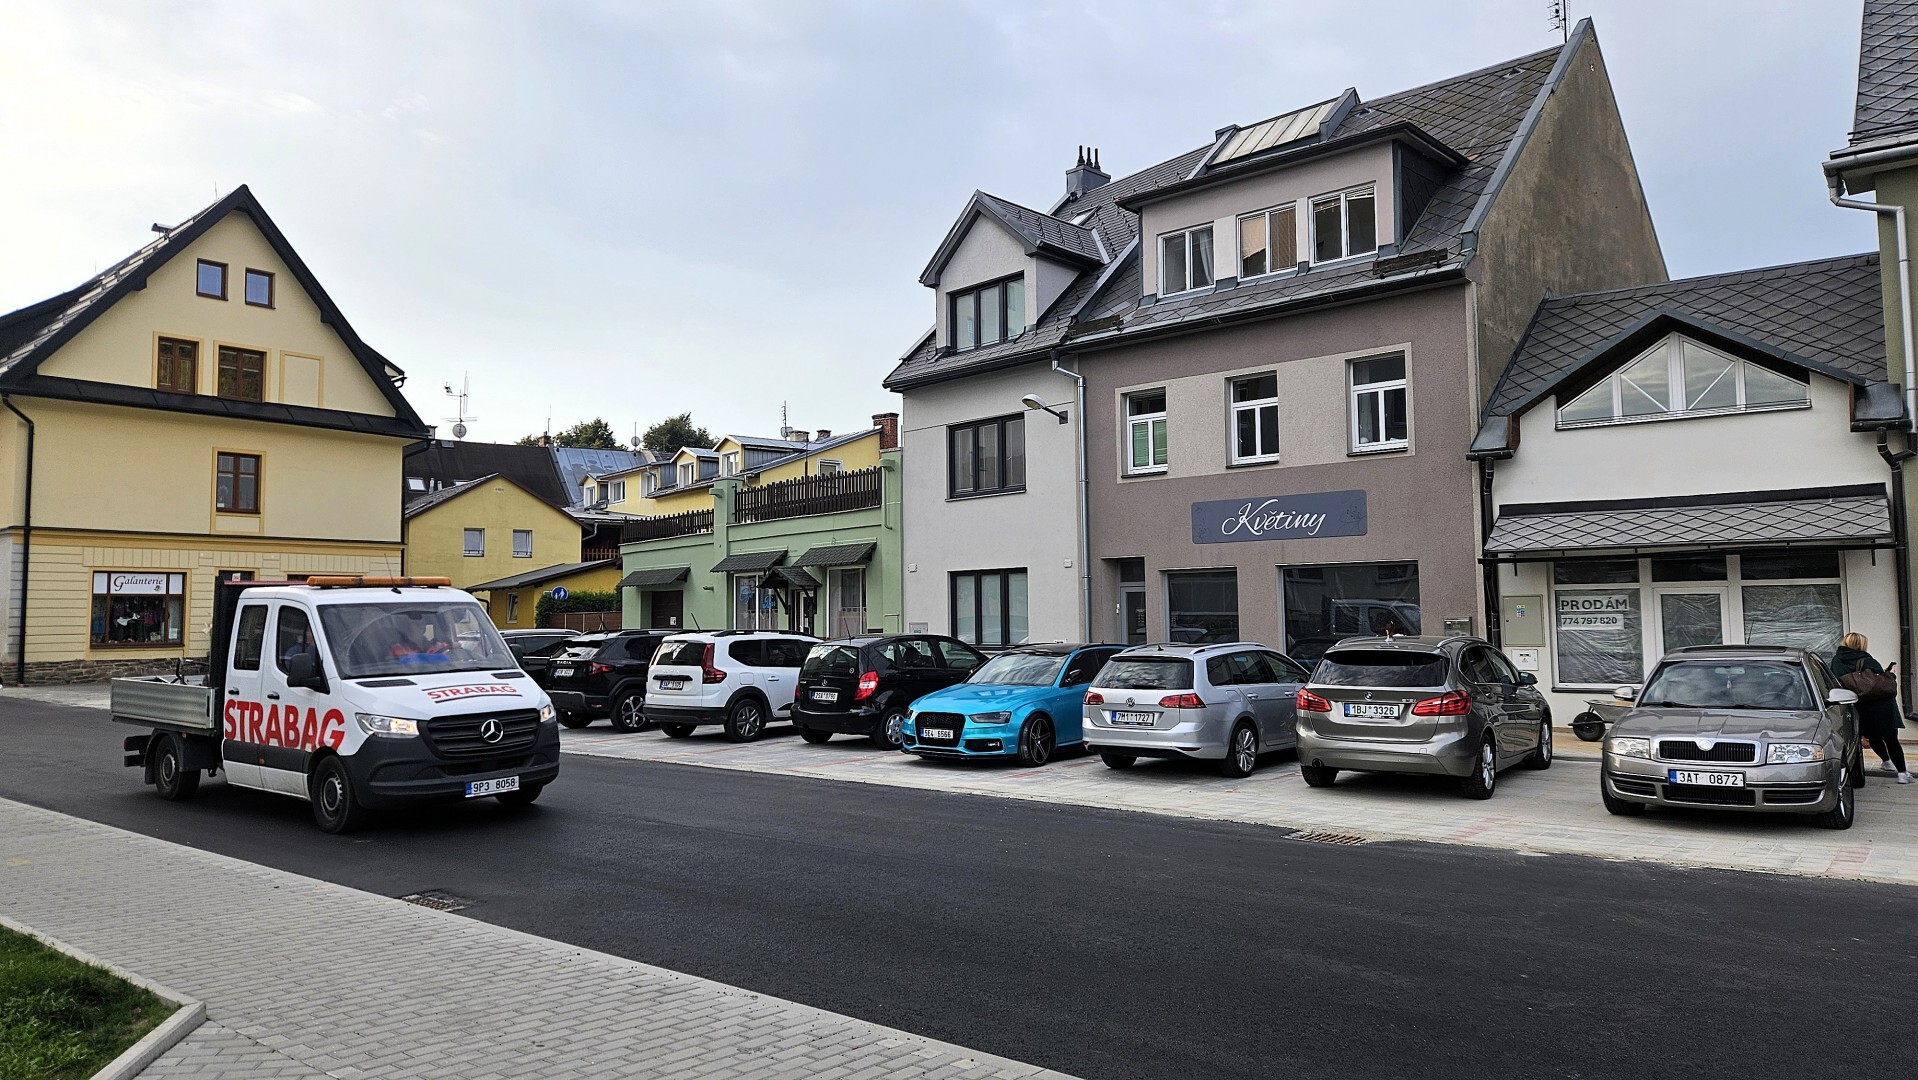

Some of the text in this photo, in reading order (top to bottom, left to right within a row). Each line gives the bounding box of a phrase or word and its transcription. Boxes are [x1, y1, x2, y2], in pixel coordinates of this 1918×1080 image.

[1222, 499, 1326, 536] Květiny
[113, 575, 163, 592] Galanterie
[1561, 597, 1628, 610] PRODÁM
[1562, 617, 1579, 625] 774
[1581, 617, 1598, 625] 797
[427, 686, 517, 699] STRABAG
[1352, 705, 1394, 715] 1BJ 3326
[1117, 713, 1150, 722] 7M1 1727
[224, 699, 345, 753] STRABAG
[473, 778, 515, 792] 9P3 8058
[1680, 772, 1738, 785] 3AT 0872
